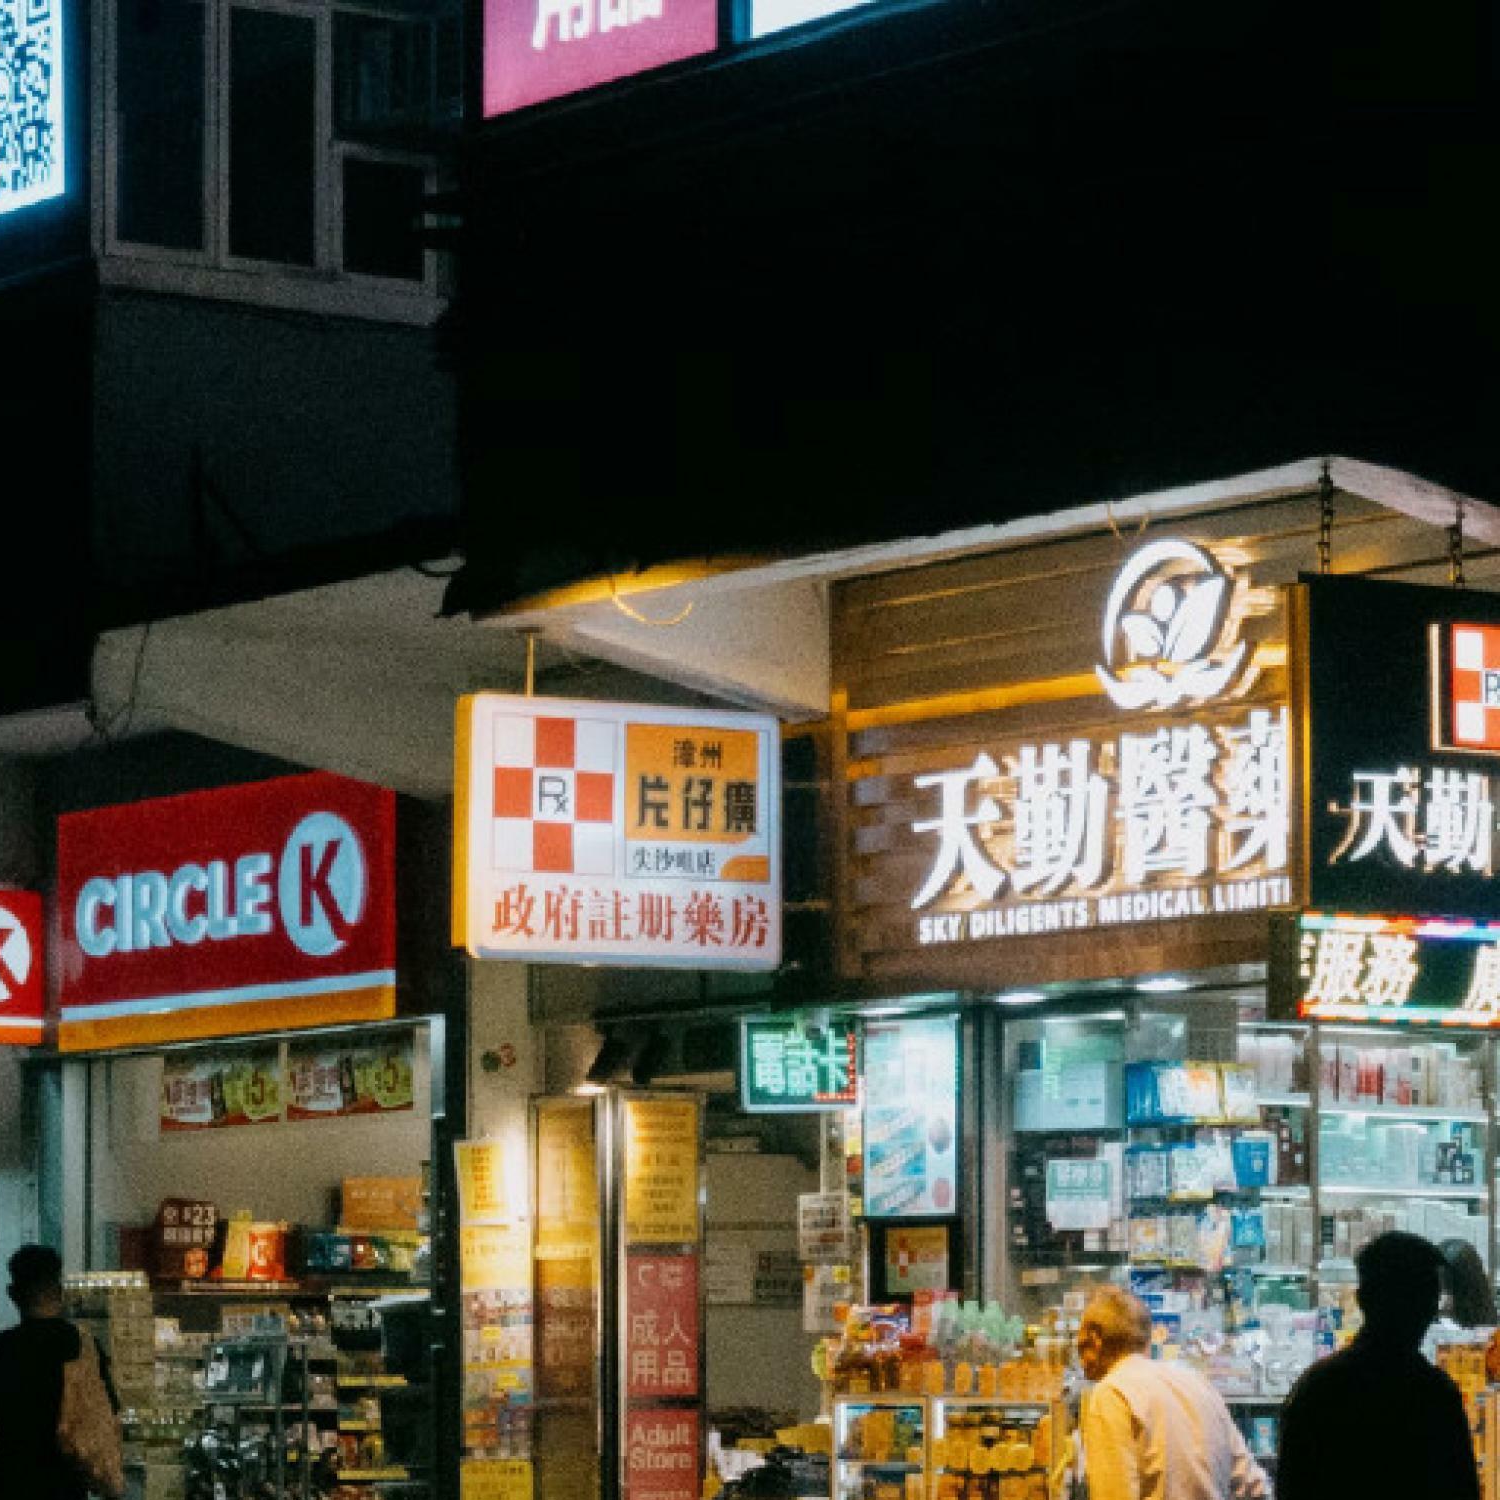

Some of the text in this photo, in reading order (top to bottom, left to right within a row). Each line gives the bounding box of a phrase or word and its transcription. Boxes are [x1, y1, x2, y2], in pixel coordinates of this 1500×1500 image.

[75, 836, 364, 957] CIRCLE K
[919, 914, 962, 945] SKY
[969, 901, 1088, 939] DILIGENTS
[1099, 887, 1206, 925] MEDICAL
[631, 1310, 691, 1346] 成人
[631, 1351, 692, 1387] 用品
[631, 1423, 690, 1447] Adult
[629, 1447, 692, 1470] Store
